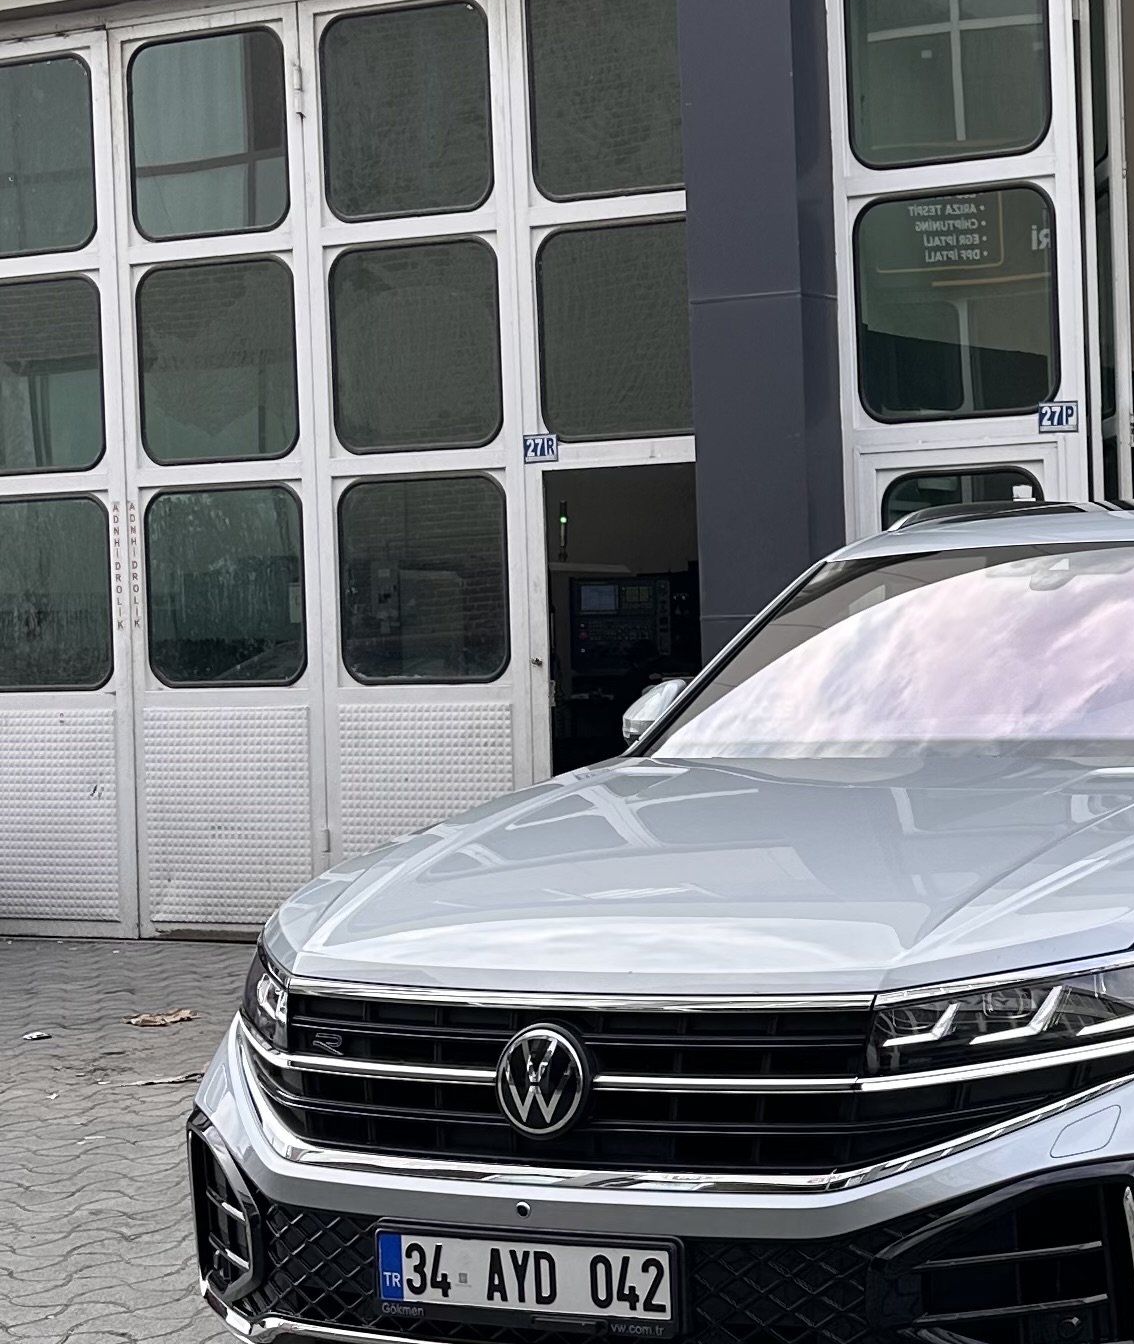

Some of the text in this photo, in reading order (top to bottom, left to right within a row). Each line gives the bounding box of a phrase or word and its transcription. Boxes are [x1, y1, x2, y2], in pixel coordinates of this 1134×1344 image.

[383, 1271, 401, 1288] TR
[405, 1242, 667, 1313] 34 AYD 042
[382, 1302, 425, 1317] Gökmen
[610, 1322, 665, 1337] vw.com.tr
